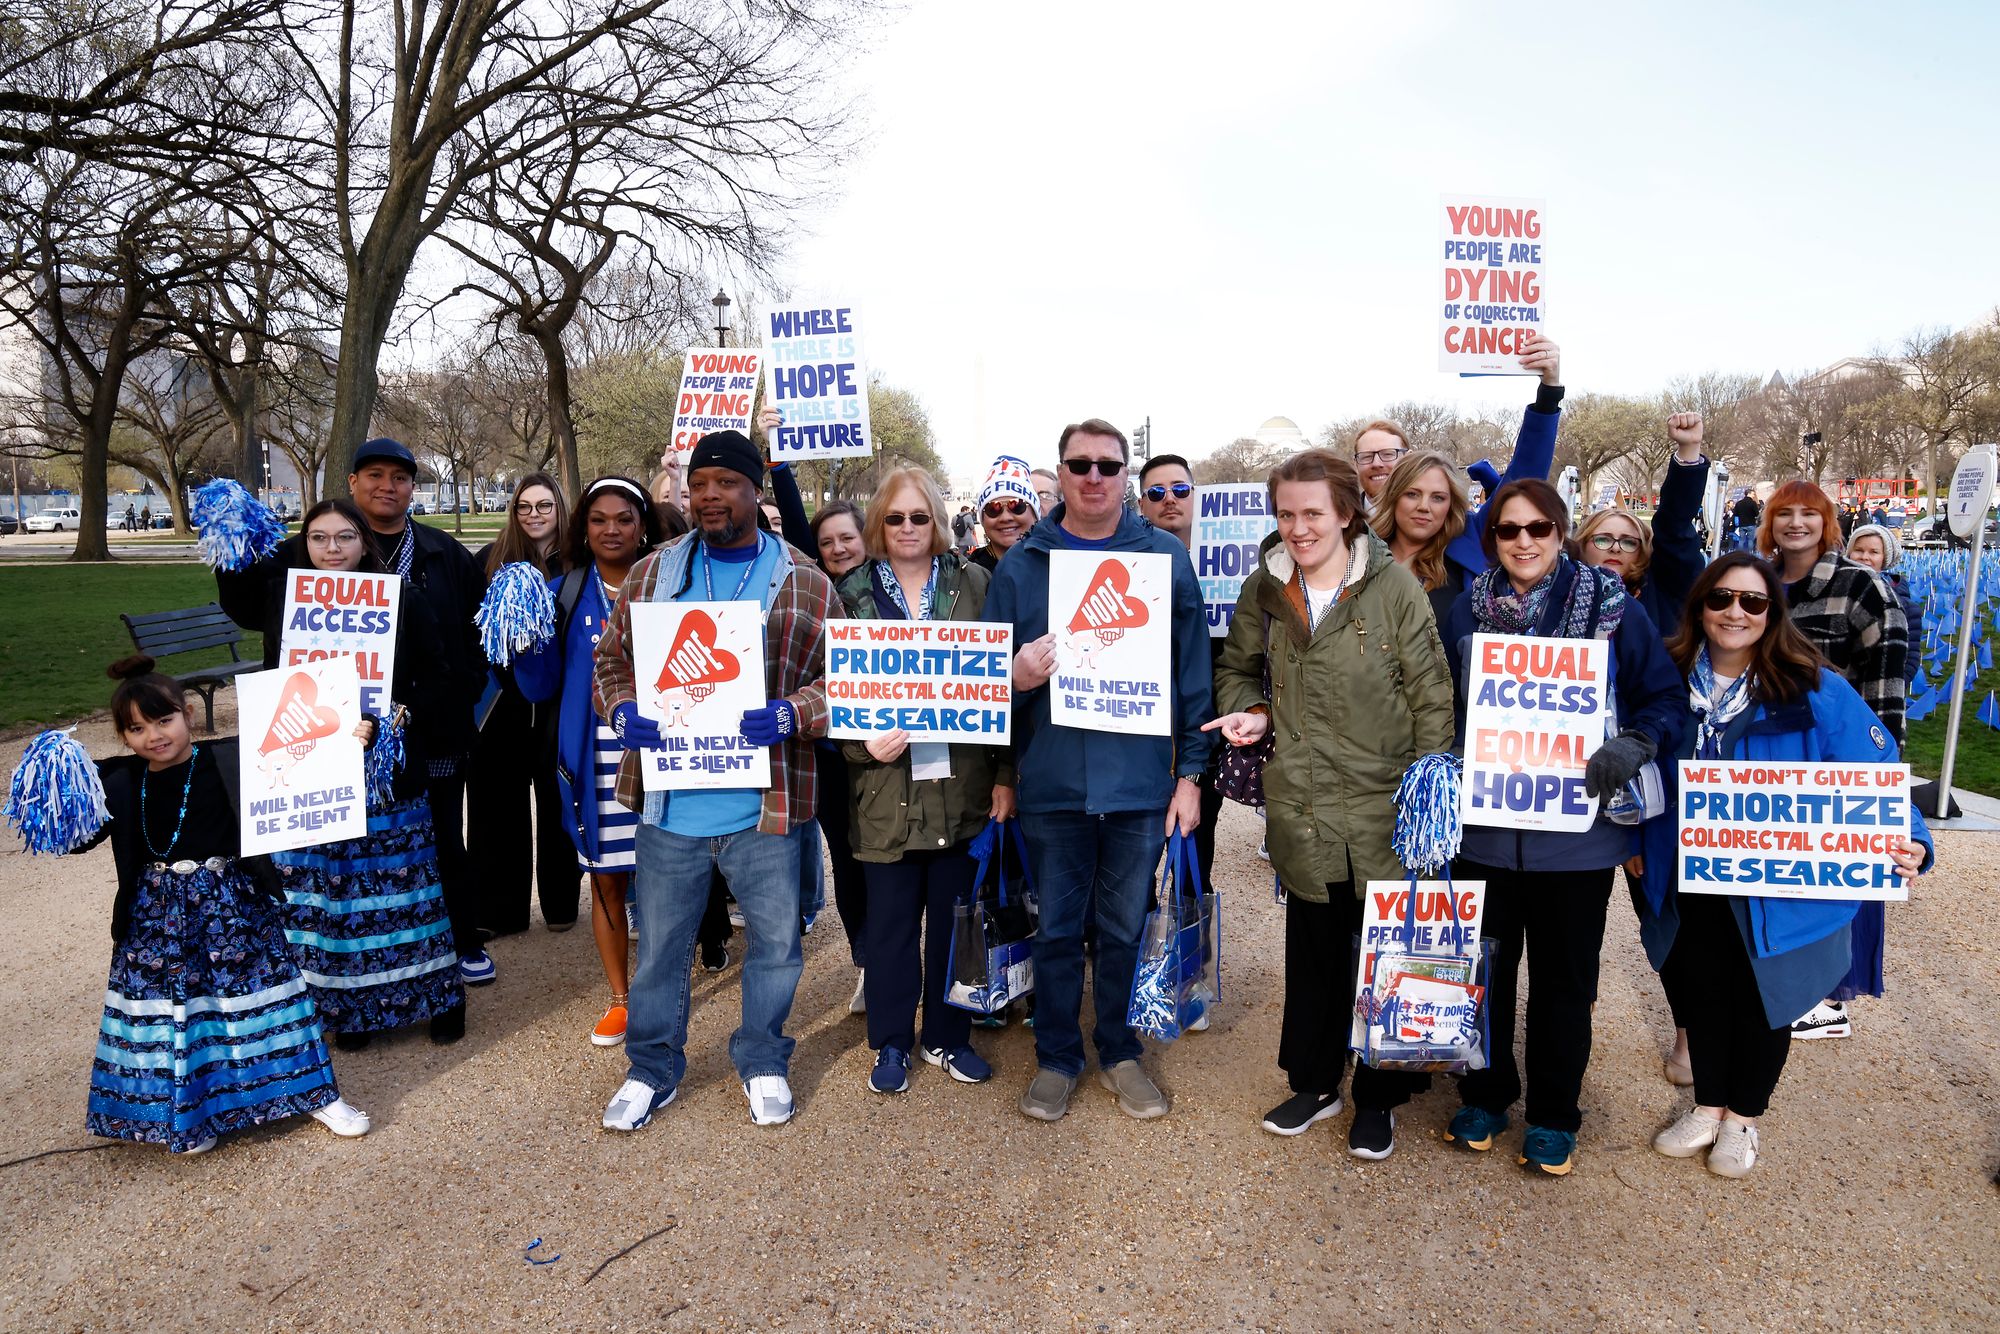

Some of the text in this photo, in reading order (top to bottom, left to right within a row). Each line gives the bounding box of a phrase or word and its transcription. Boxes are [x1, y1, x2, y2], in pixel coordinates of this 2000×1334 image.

[1446, 205, 1541, 239] YOUNG
[1444, 240, 1541, 267] PEOPLE ARE
[1445, 268, 1540, 304] DYING
[770, 308, 852, 338] WHERE
[1444, 304, 1540, 325] OF COLORECTAL
[771, 337, 855, 362] THERE IS
[691, 354, 757, 374] YOUNG
[683, 376, 755, 393] PEOPLE ARE
[774, 363, 857, 400] HOPE
[679, 393, 749, 417] DYING
[779, 399, 860, 423] THERE IS
[676, 416, 747, 431] OF COLORECTAL
[777, 423, 864, 451] FUTURE
[995, 480, 1038, 504] FIGHT
[1199, 520, 1258, 541] THERE
[1199, 543, 1260, 577] HOP
[294, 575, 390, 611] EQUAL
[1081, 576, 1135, 628] HOPE
[1200, 579, 1241, 600] THER
[289, 607, 391, 635] ACCESS
[829, 626, 1009, 643] WE WON'T GIVE UP
[288, 649, 384, 680] EAL
[667, 629, 725, 685] HOPE
[1481, 641, 1596, 684] EQUAL
[827, 680, 1010, 703] COLORECTAL CANCER
[1058, 675, 1161, 697] WILL NEVER
[1475, 678, 1598, 715] ACCESS
[1064, 694, 1088, 711] BE
[271, 690, 325, 745] HOPE
[831, 706, 1006, 733] RESEARCH
[694, 736, 759, 751] NEVE
[1475, 728, 1590, 773] EQUAL
[657, 756, 682, 771] BE
[1683, 767, 1905, 787] WE WON'T GIVE UP
[250, 785, 356, 817] WILL NEVER
[1471, 770, 1589, 816] HOPE
[256, 817, 281, 836] BE
[1680, 827, 1813, 851] COLORECTAL
[1684, 856, 1903, 889] RESEARCH
[1373, 891, 1477, 922] YOUNG
[1459, 995, 1478, 1039] FIGH
